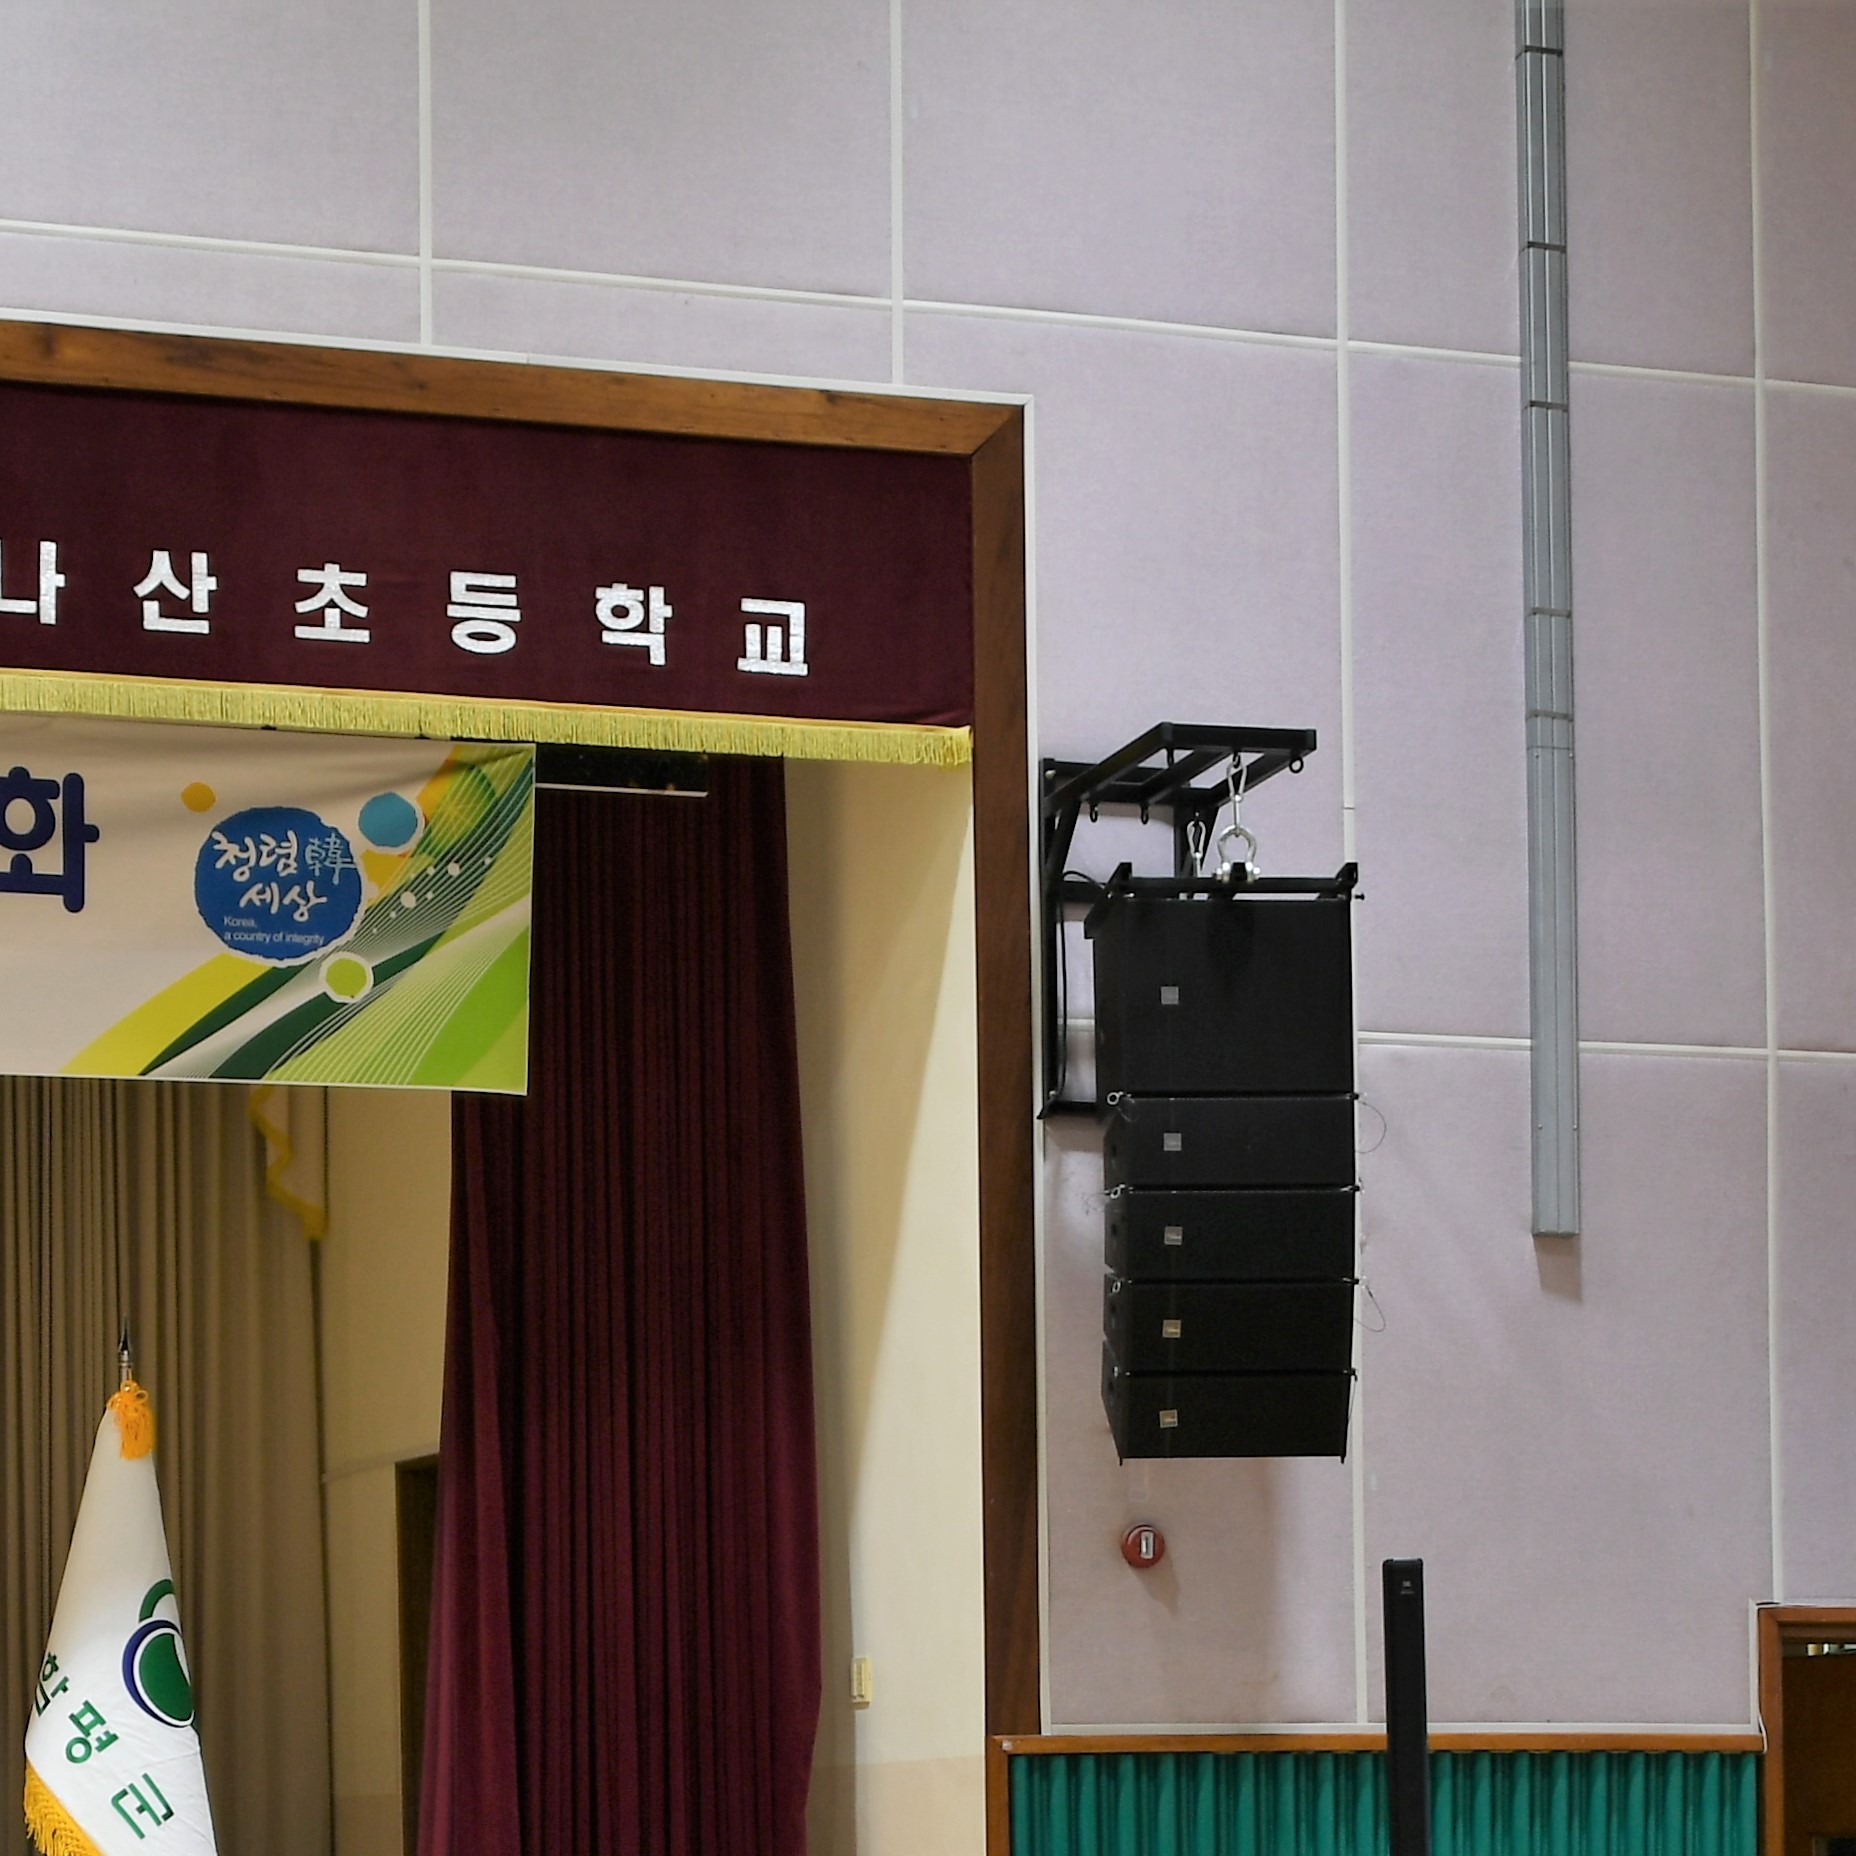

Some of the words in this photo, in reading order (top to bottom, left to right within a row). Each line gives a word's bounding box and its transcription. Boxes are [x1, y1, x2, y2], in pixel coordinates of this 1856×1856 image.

[239, 880, 328, 922] 세상
[223, 916, 258, 928] Korea,
[224, 933, 231, 942] a
[233, 931, 270, 944] country
[272, 931, 283, 943] of
[285, 932, 325, 946] integrity
